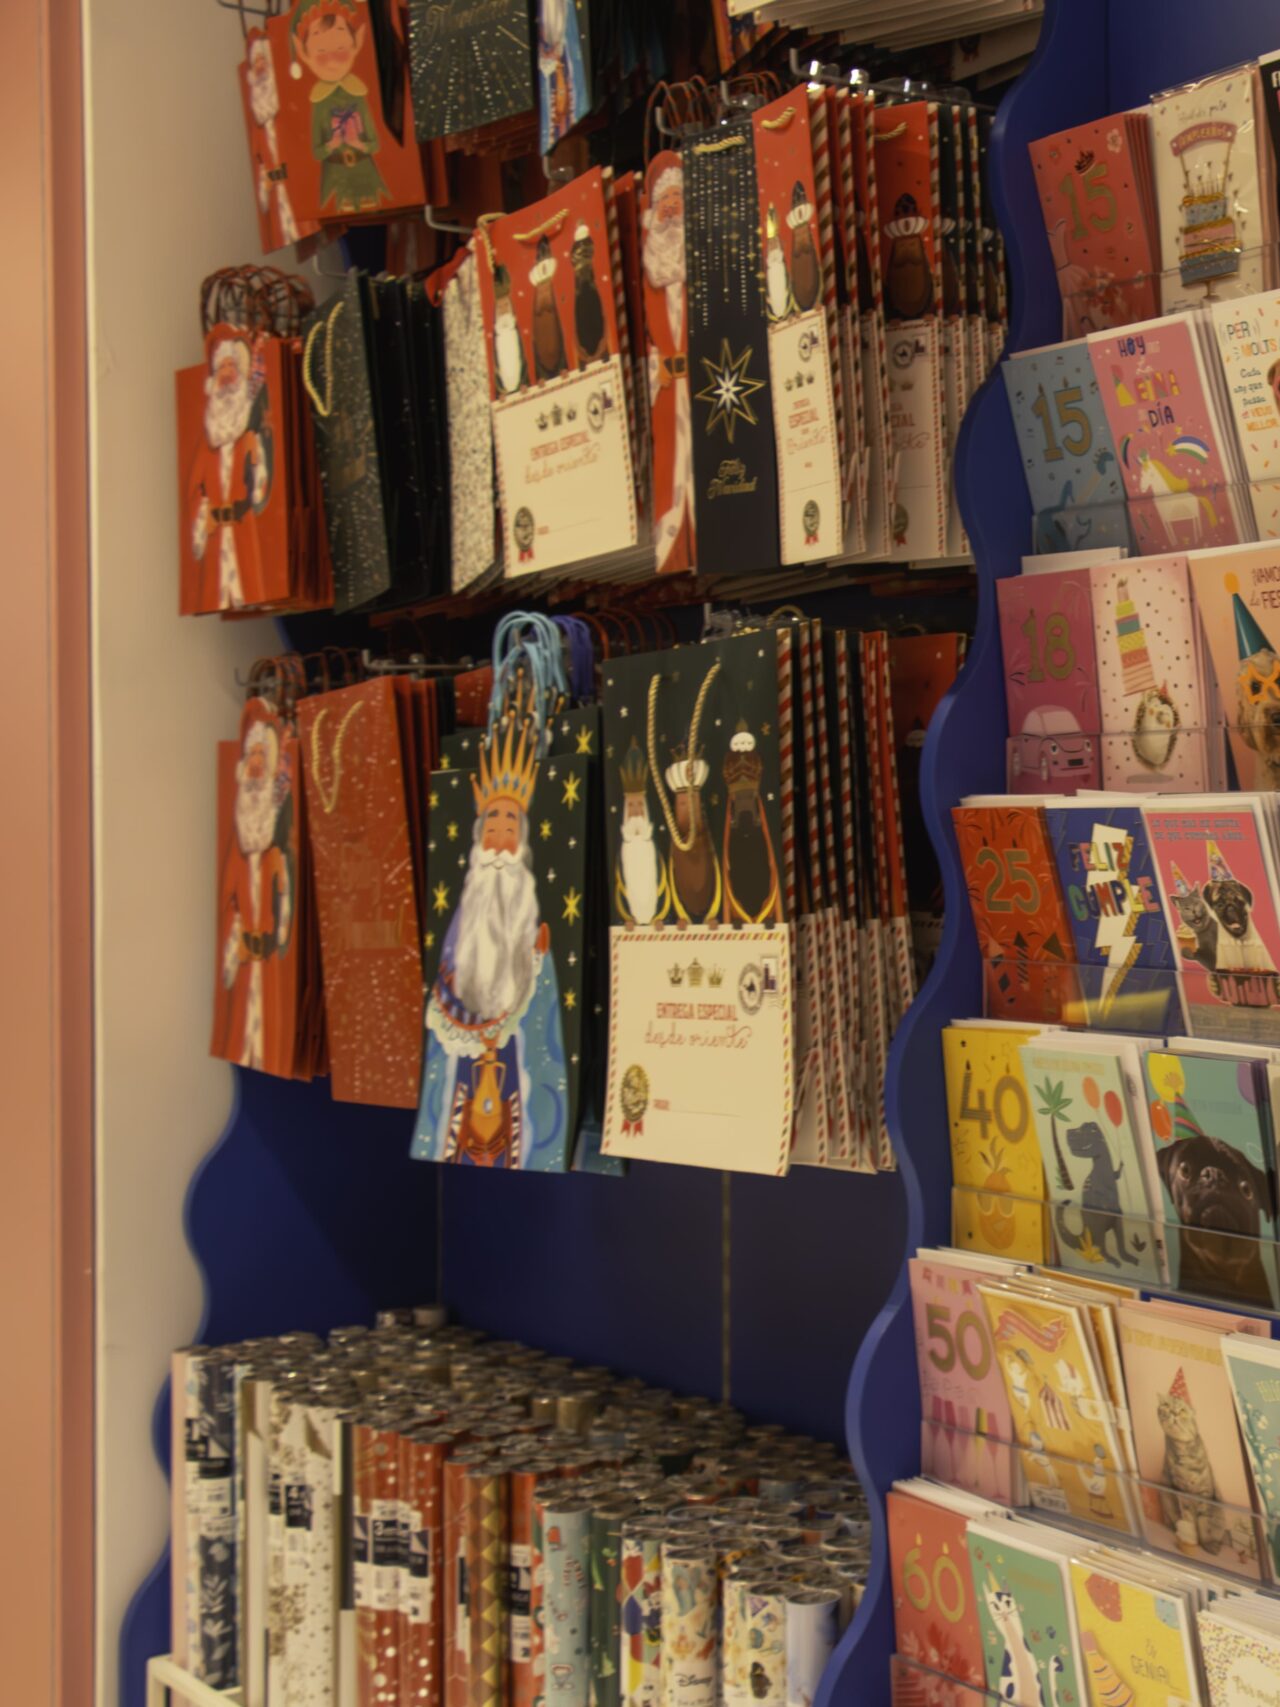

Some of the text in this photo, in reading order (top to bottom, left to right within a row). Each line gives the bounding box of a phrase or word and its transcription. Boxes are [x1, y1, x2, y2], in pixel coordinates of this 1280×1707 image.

[1058, 163, 1118, 242] 15
[1117, 335, 1146, 358] HOY
[1226, 320, 1251, 340] PER
[1031, 378, 1092, 464] 15
[1147, 401, 1175, 428] DÍA
[1021, 611, 1077, 684] 18
[976, 848, 1041, 914] 25
[1068, 842, 1130, 873] FELIZ
[1067, 876, 1160, 921] CUMPLE
[960, 1068, 1029, 1144] 40
[924, 1303, 992, 1382] 50
[903, 1545, 967, 1625] 60
